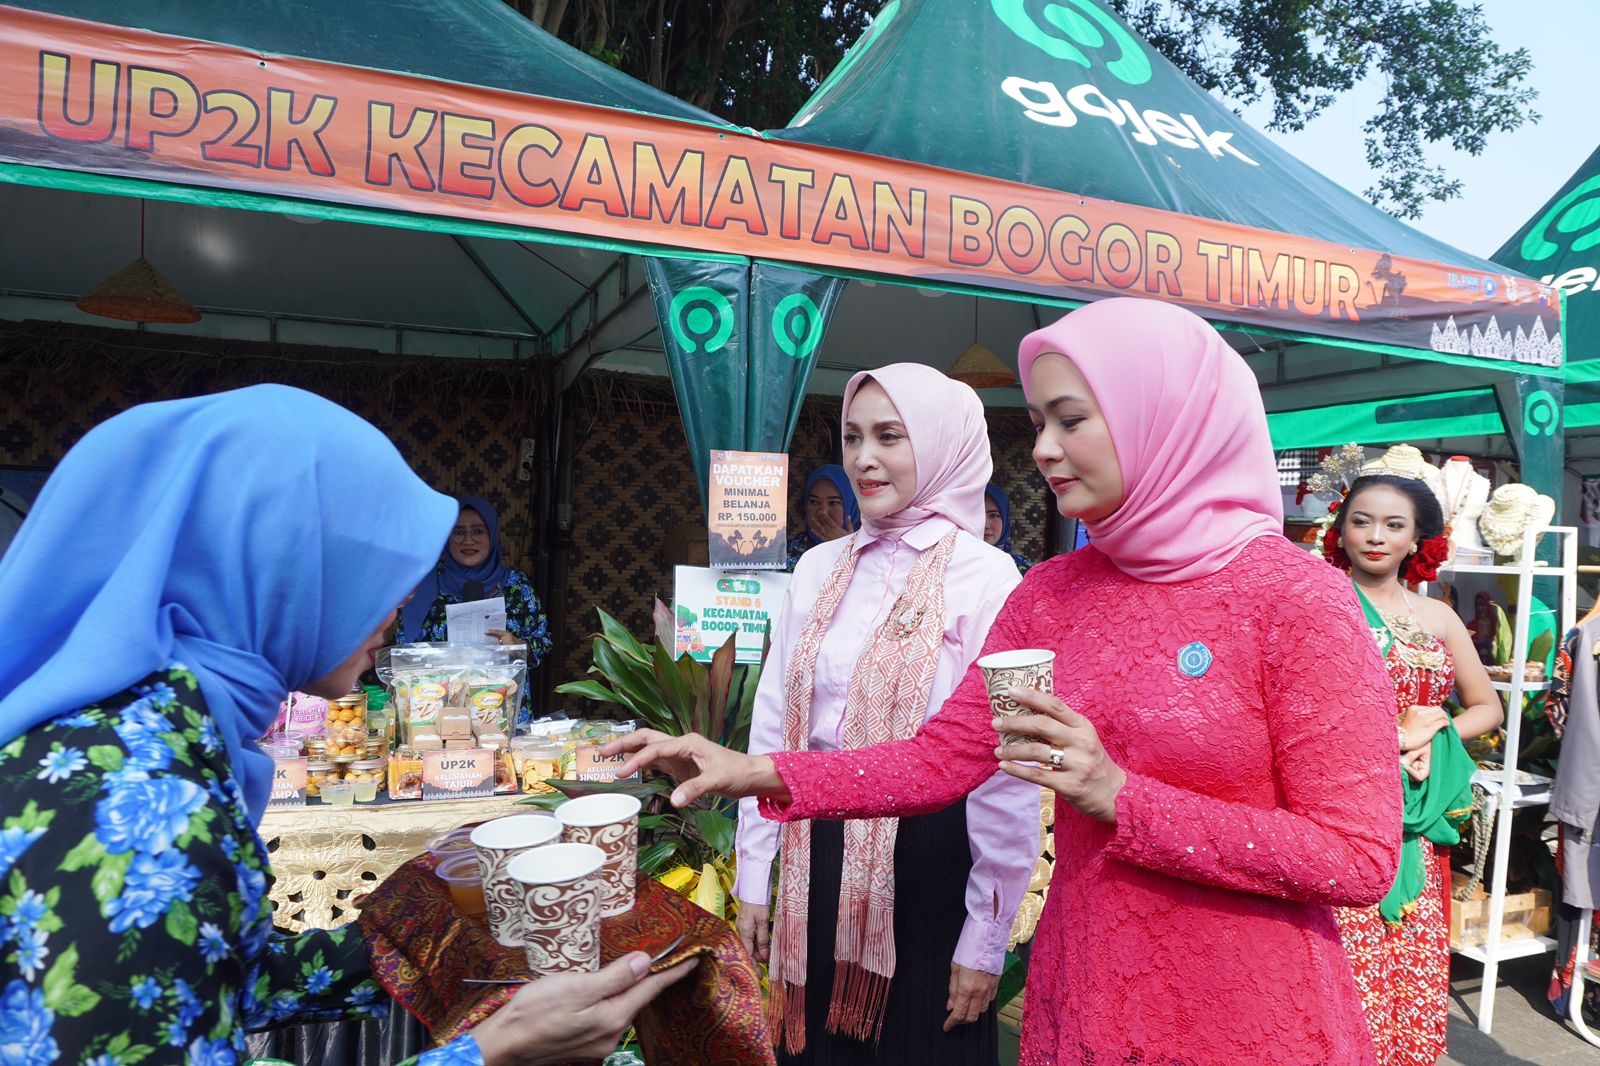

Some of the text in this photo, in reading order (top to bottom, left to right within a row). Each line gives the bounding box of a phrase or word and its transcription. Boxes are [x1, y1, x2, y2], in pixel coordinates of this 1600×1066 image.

[1000, 76, 1260, 166] gojek
[38, 50, 1361, 322] UP2K KECAMATAN BOGOR TIMUR
[713, 464, 784, 476] DAPATKAN
[715, 475, 780, 487] VOUCHER
[724, 488, 769, 497] MINIMAL
[723, 500, 771, 509] BELANJA
[718, 513, 777, 522] RP. 150.000
[715, 595, 752, 607] STAND
[703, 608, 768, 620] KECAMATAN
[742, 622, 772, 634] TIMU
[440, 760, 476, 770] UP2K
[587, 765, 622, 773] KELURAH
[435, 772, 482, 781] KELURAHAN
[444, 780, 473, 788] TAJUR
